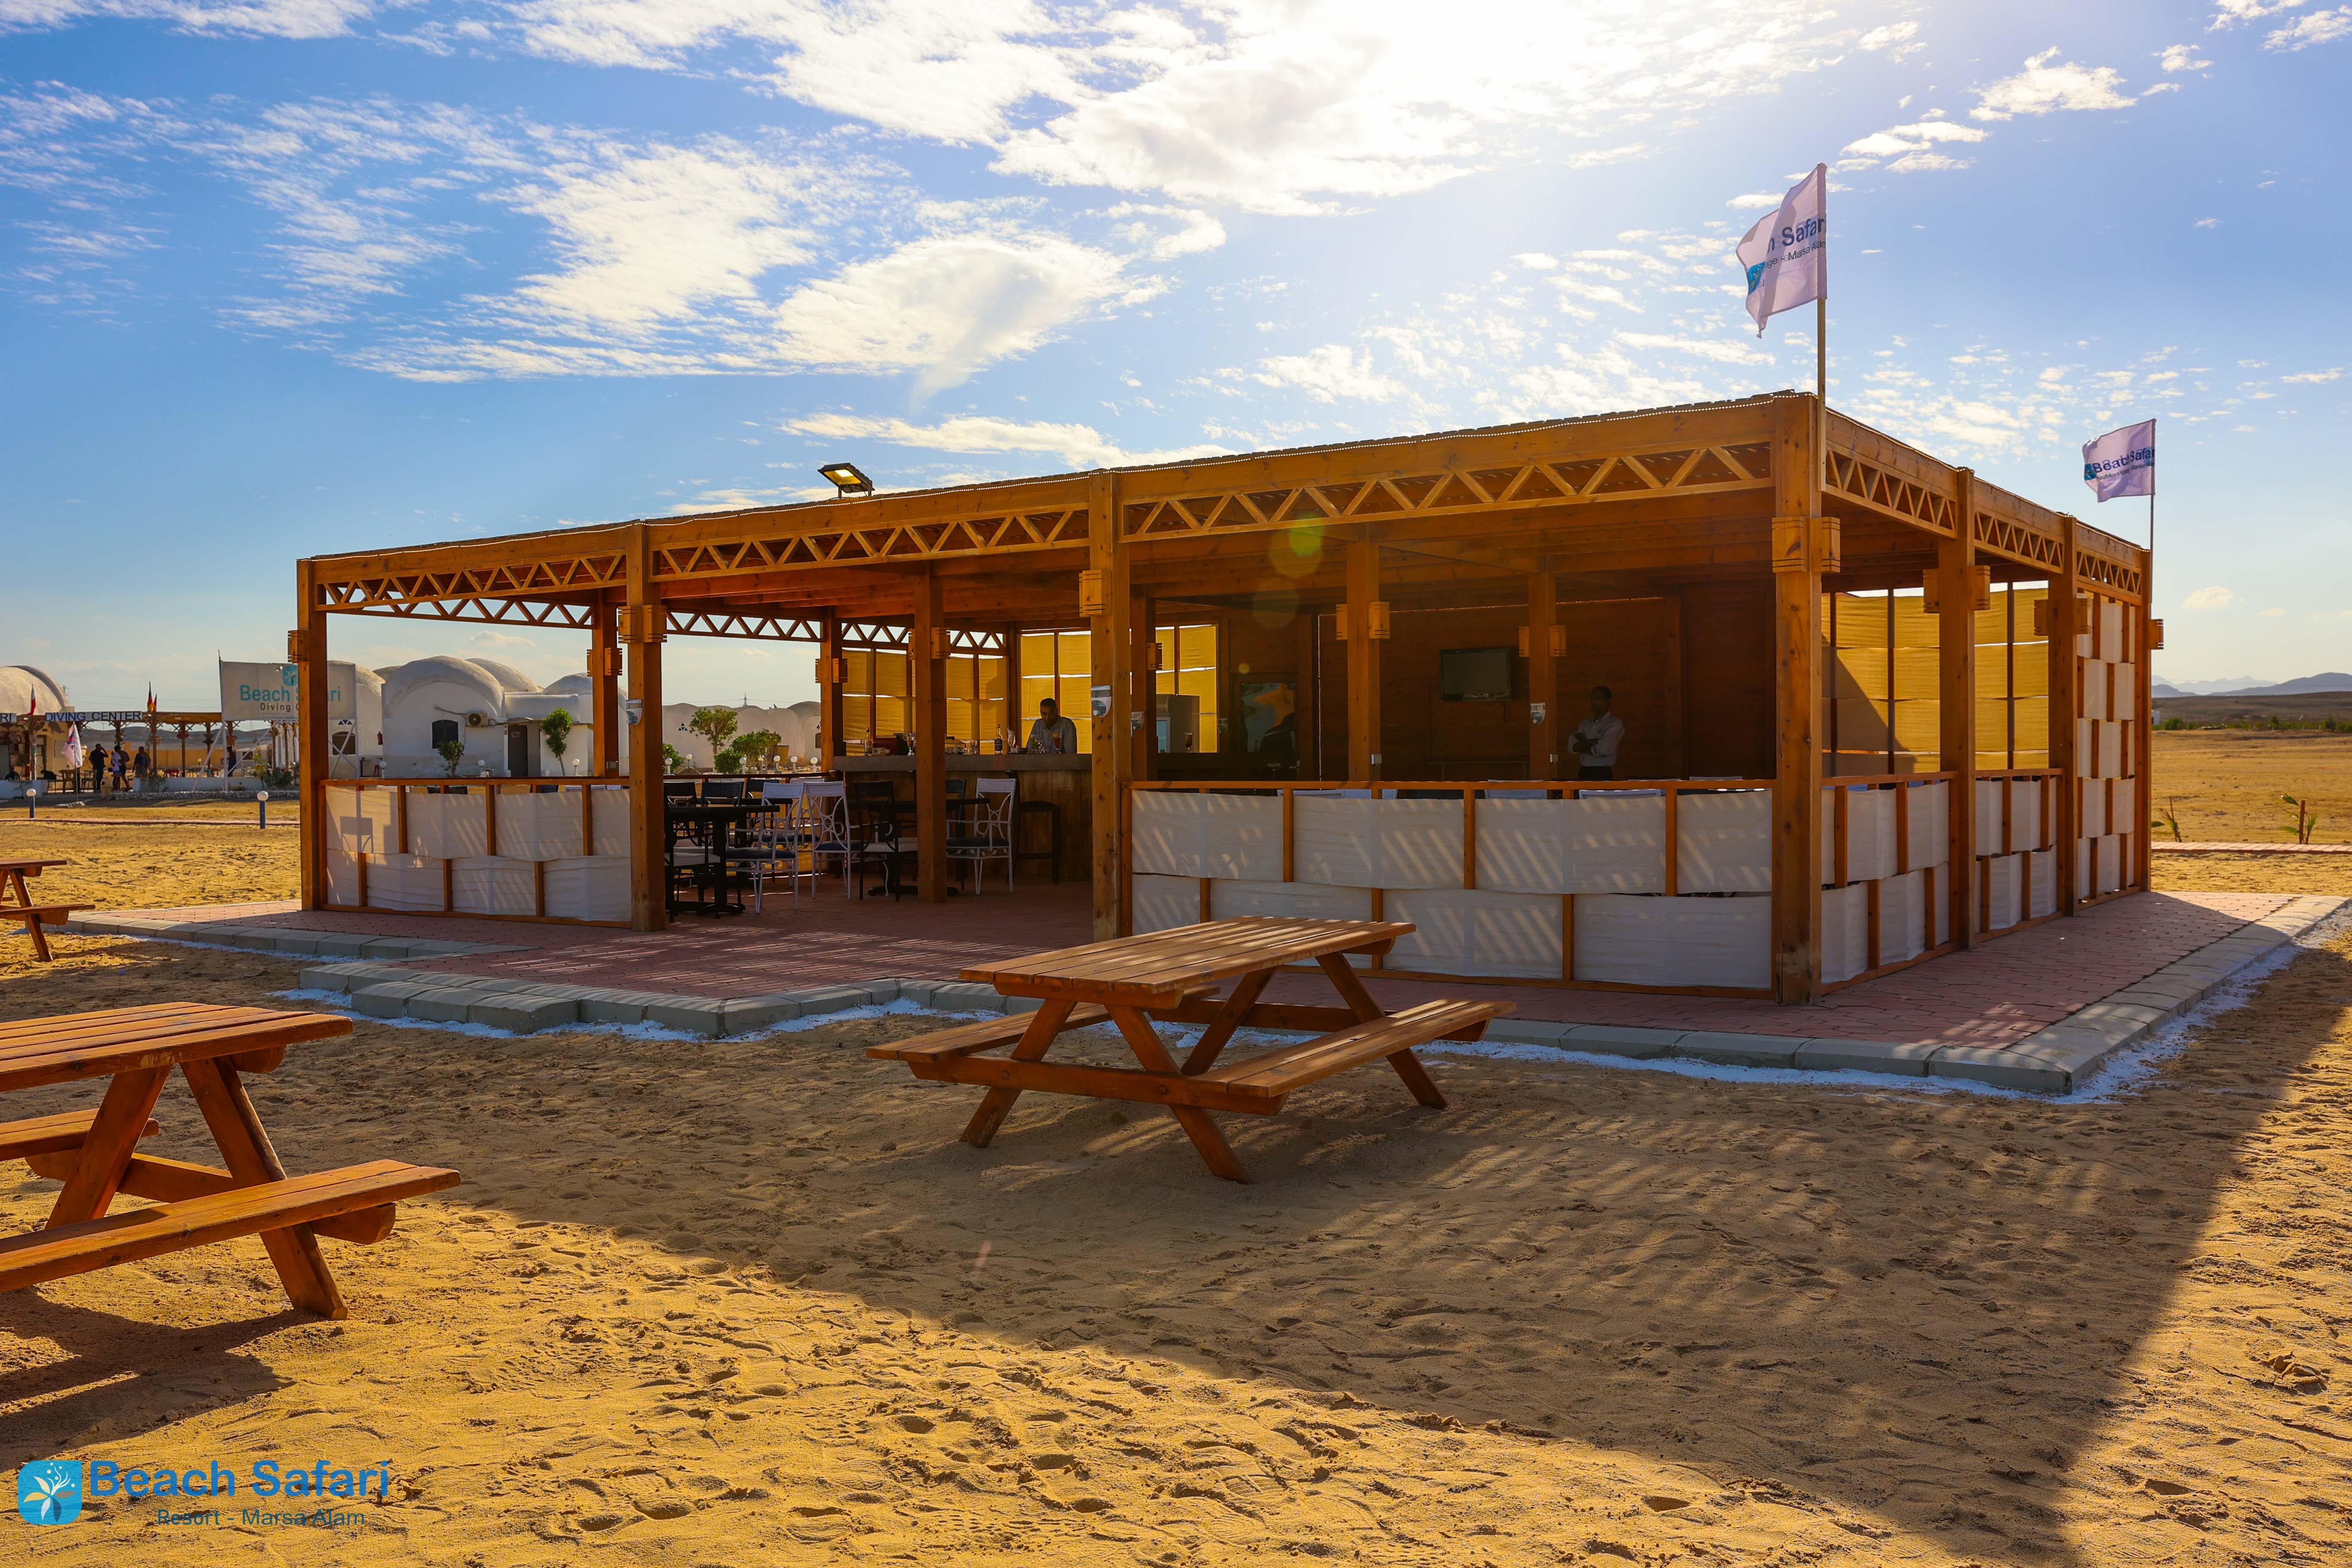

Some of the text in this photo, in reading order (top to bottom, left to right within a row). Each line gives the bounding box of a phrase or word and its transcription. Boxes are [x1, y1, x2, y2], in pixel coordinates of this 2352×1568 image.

[1788, 246, 1810, 260] Marsa
[240, 685, 290, 701] Beach
[260, 703, 291, 712] Diving
[45, 711, 141, 721] DIVING CENTER
